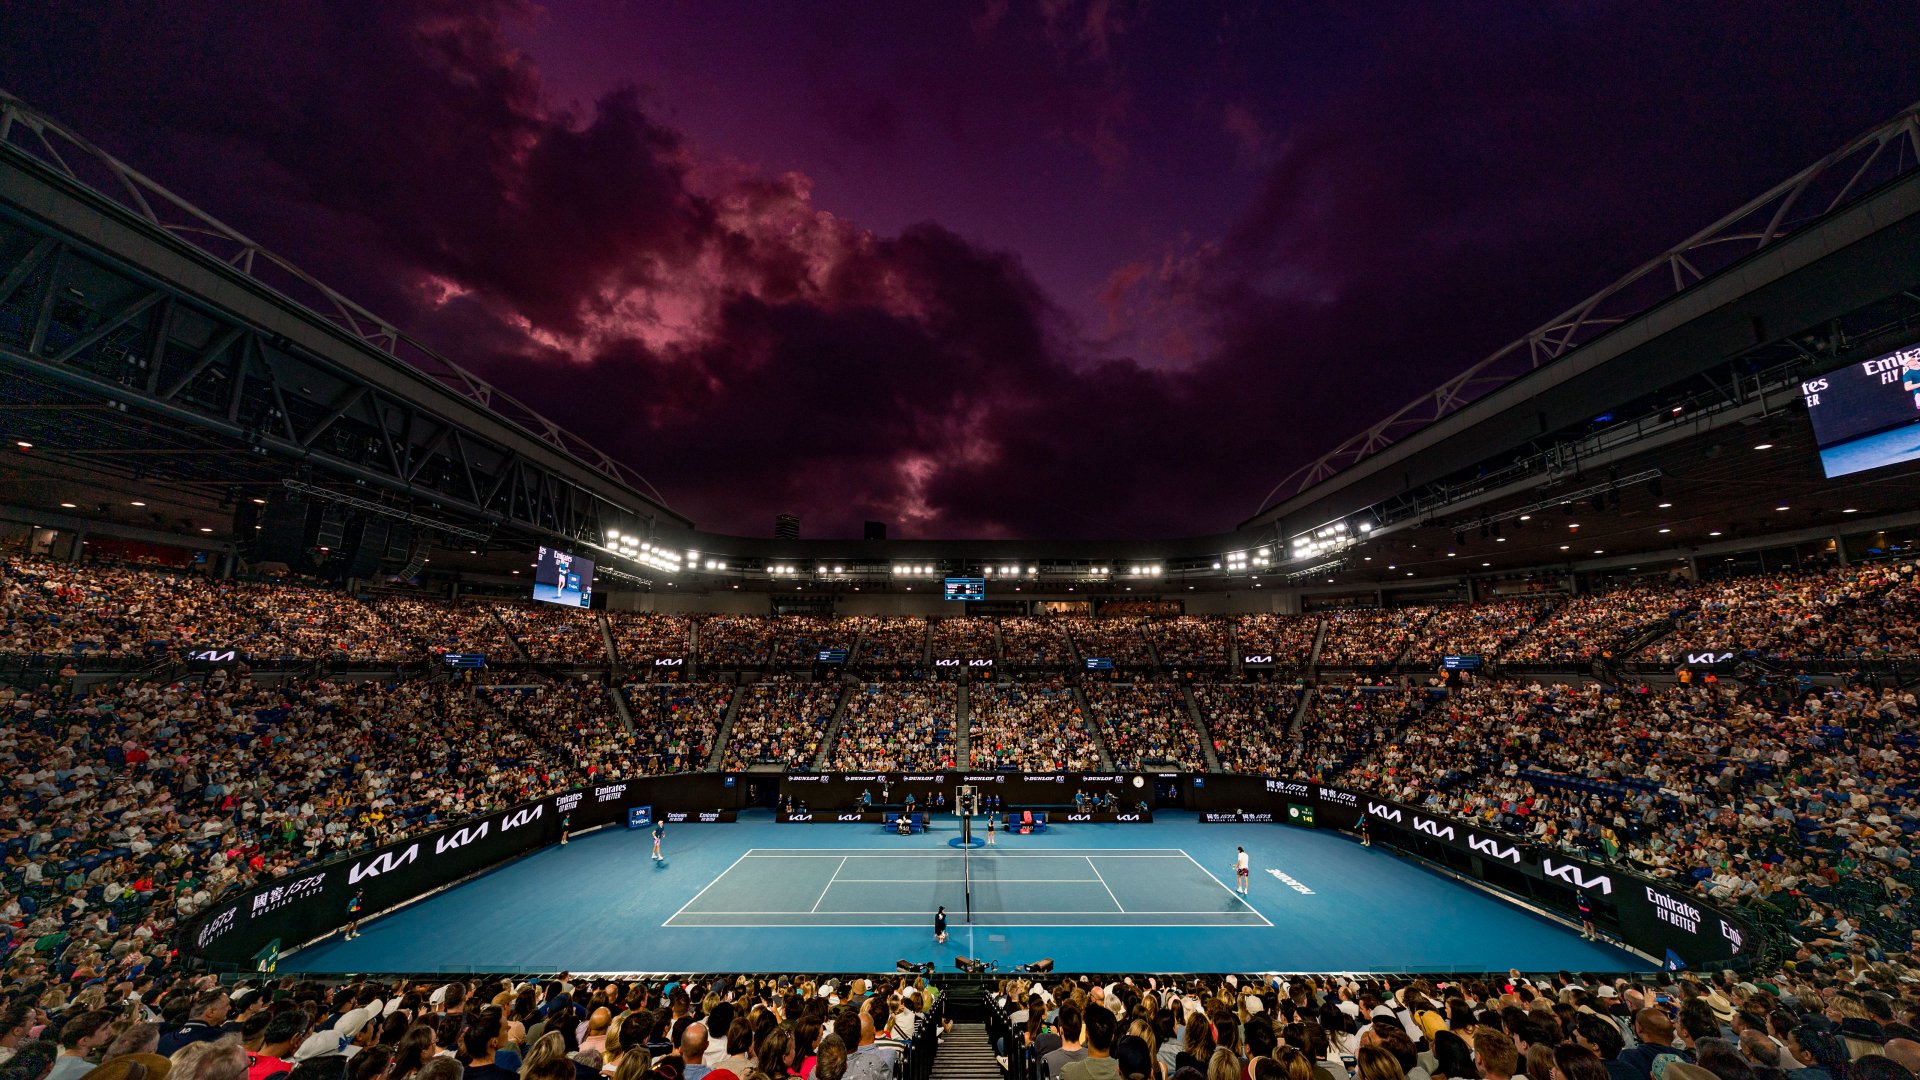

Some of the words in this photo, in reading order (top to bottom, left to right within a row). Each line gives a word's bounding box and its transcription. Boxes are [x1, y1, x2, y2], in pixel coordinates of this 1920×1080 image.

[1881, 368, 1898, 385] FLY
[1805, 394, 1820, 408] ER
[556, 792, 582, 806] Emirates
[595, 784, 626, 796] Emirates
[502, 804, 542, 832] KIA
[1368, 802, 1401, 823] KIA
[436, 821, 488, 854] KIA
[1413, 816, 1454, 841] KIA
[1468, 834, 1520, 864] KIA
[349, 843, 418, 885] KIA
[1543, 858, 1612, 895] KIA
[300, 886, 323, 899] 1573
[1645, 886, 1700, 922] Emirates
[1657, 906, 1668, 921] FLY
[1670, 912, 1697, 934] BETTER
